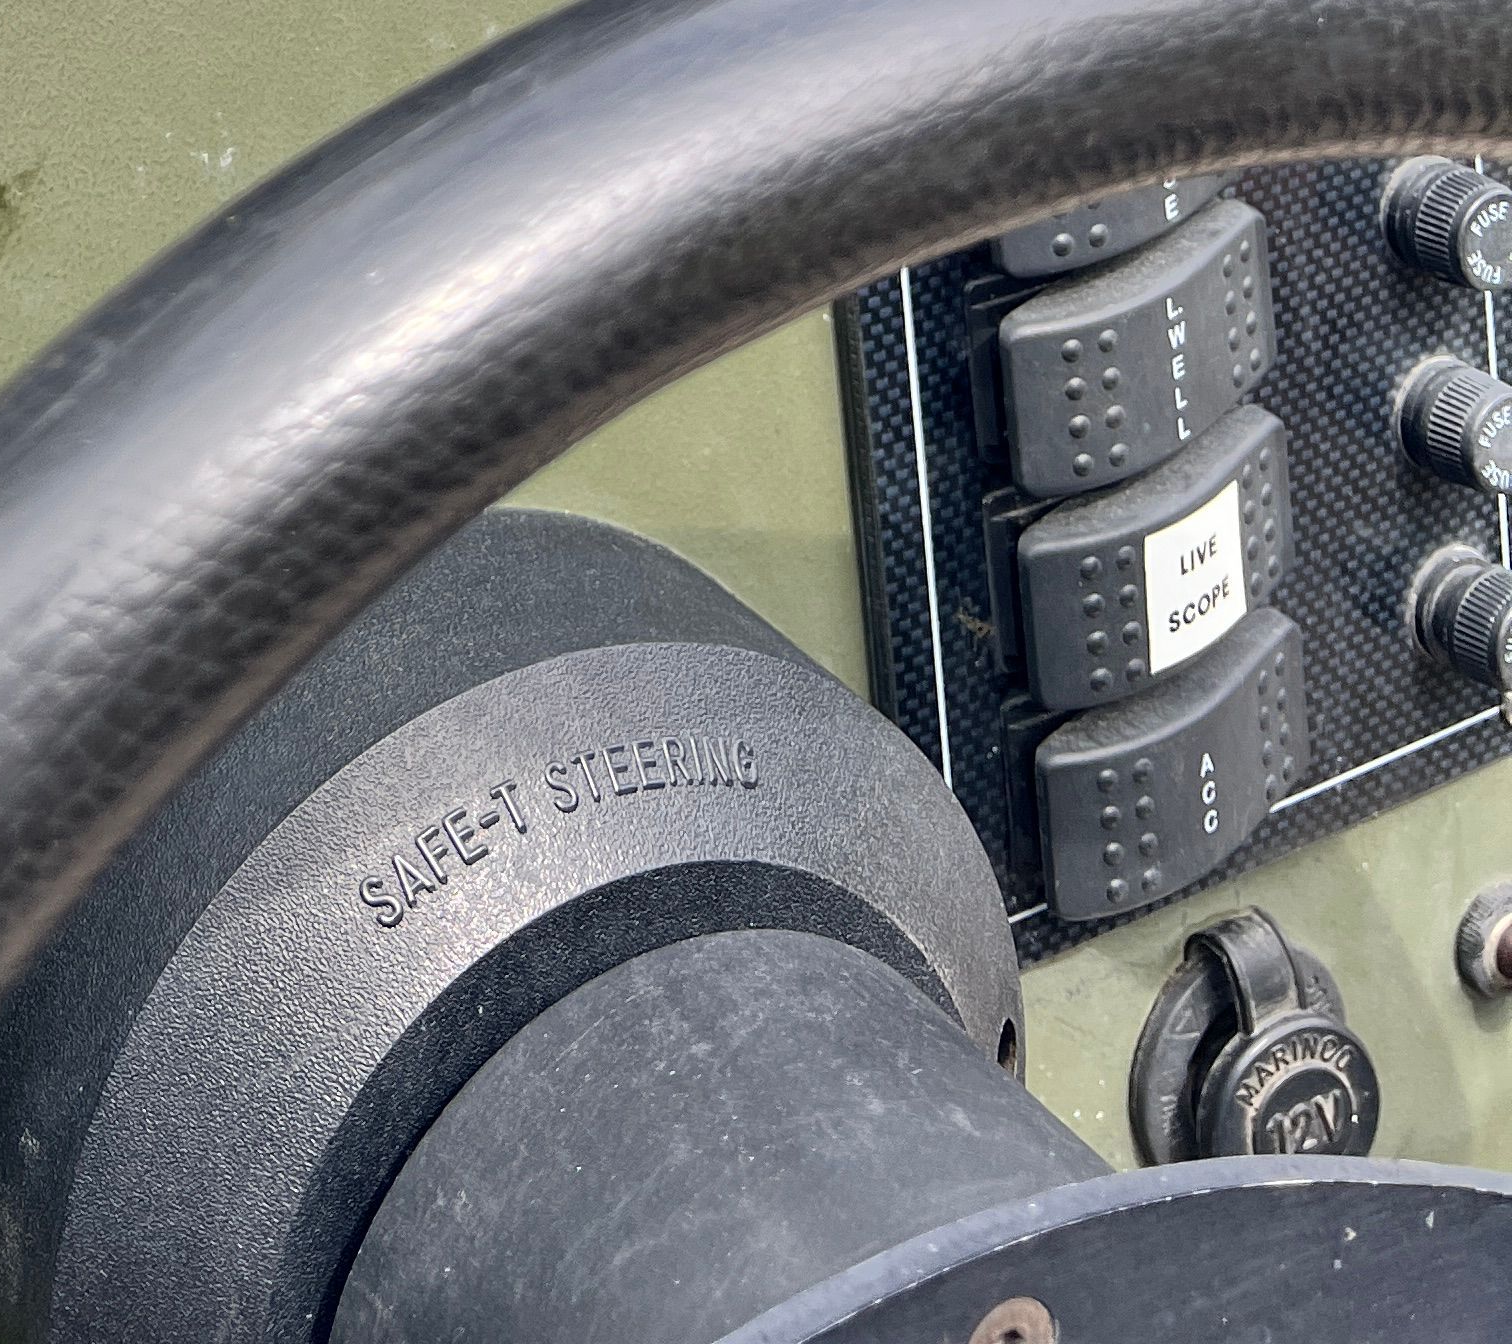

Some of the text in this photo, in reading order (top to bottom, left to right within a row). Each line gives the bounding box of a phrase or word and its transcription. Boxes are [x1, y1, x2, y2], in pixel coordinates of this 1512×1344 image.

[1470, 200, 1509, 238] FUSE
[1466, 249, 1501, 285] FUSE
[1179, 533, 1218, 576] LIVE
[1168, 574, 1231, 634] SCOPE
[1198, 751, 1219, 836] ACC
[358, 735, 760, 929] SAFE-T STEERING
[1235, 1032, 1354, 1108] MARINCO
[1265, 1088, 1343, 1156] 12V
